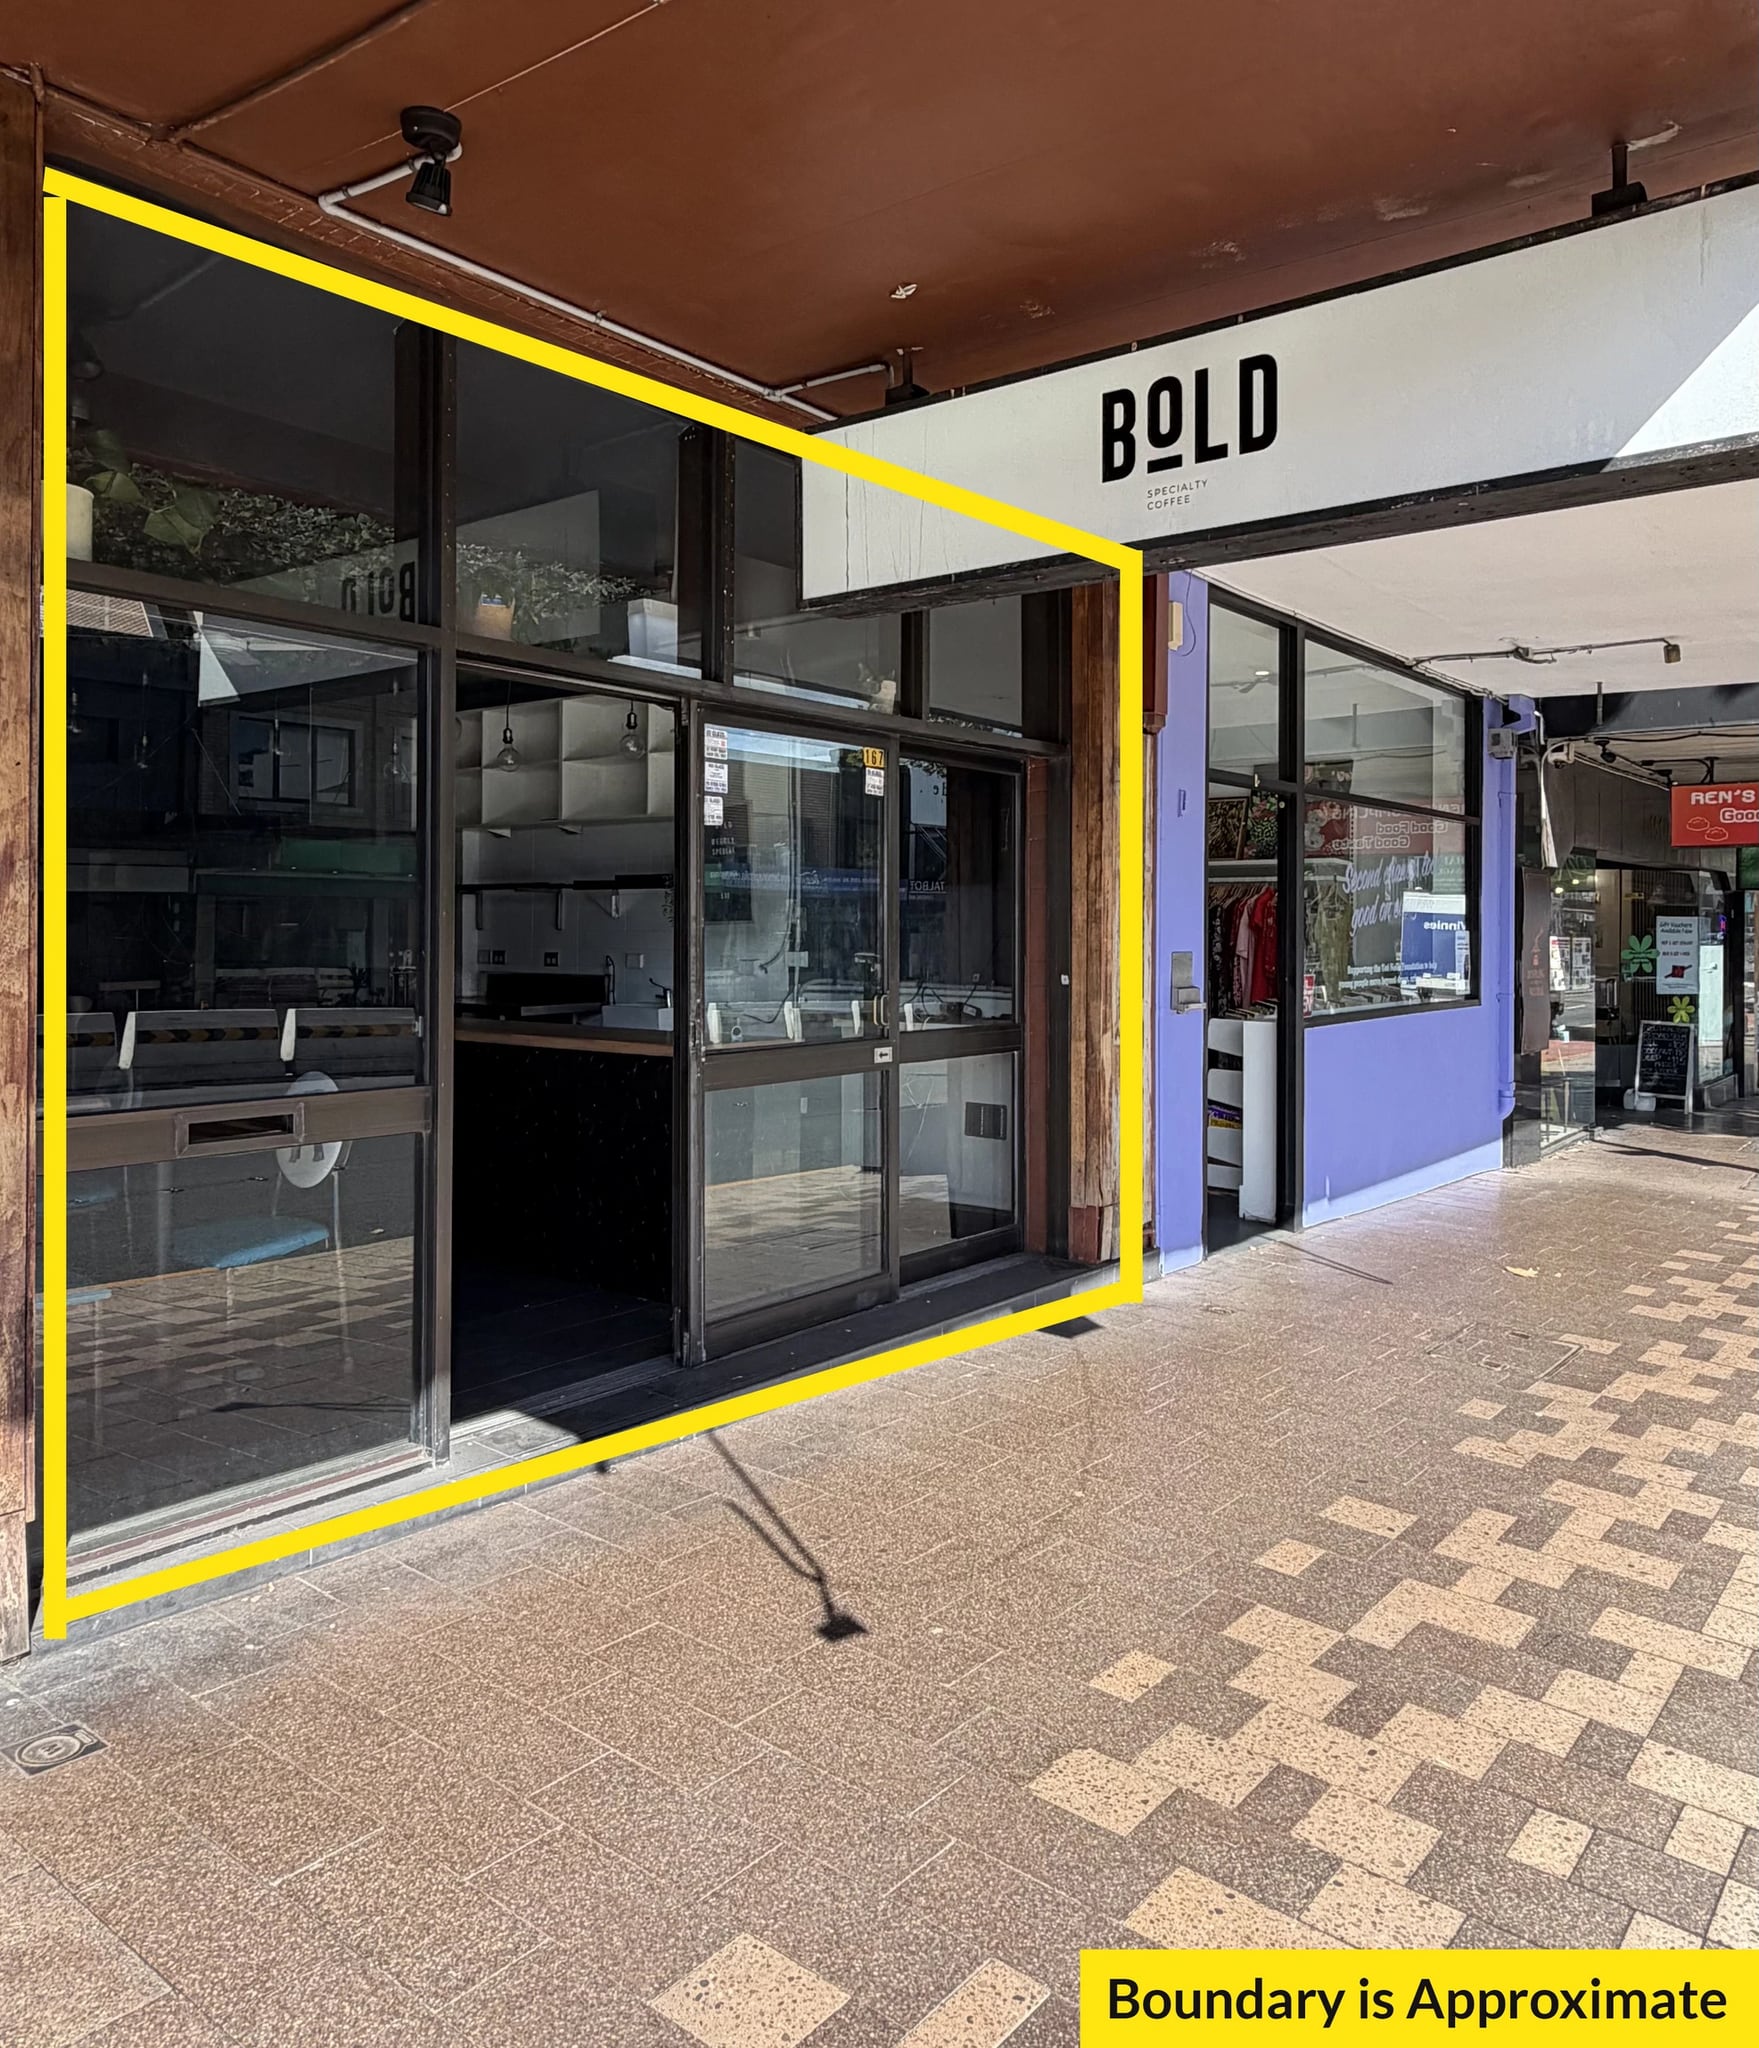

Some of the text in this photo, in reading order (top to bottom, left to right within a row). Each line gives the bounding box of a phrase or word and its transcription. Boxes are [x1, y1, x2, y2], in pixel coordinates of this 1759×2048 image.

[1102, 354, 1278, 483] BOLD
[1147, 479, 1209, 499] SPECIALTY
[1147, 494, 1191, 511] COFFEE
[865, 748, 883, 766] 167
[1691, 789, 1756, 805] REN'S
[1720, 807, 1759, 824] Goo
[1342, 857, 1384, 894] Second
[1349, 893, 1380, 937] good
